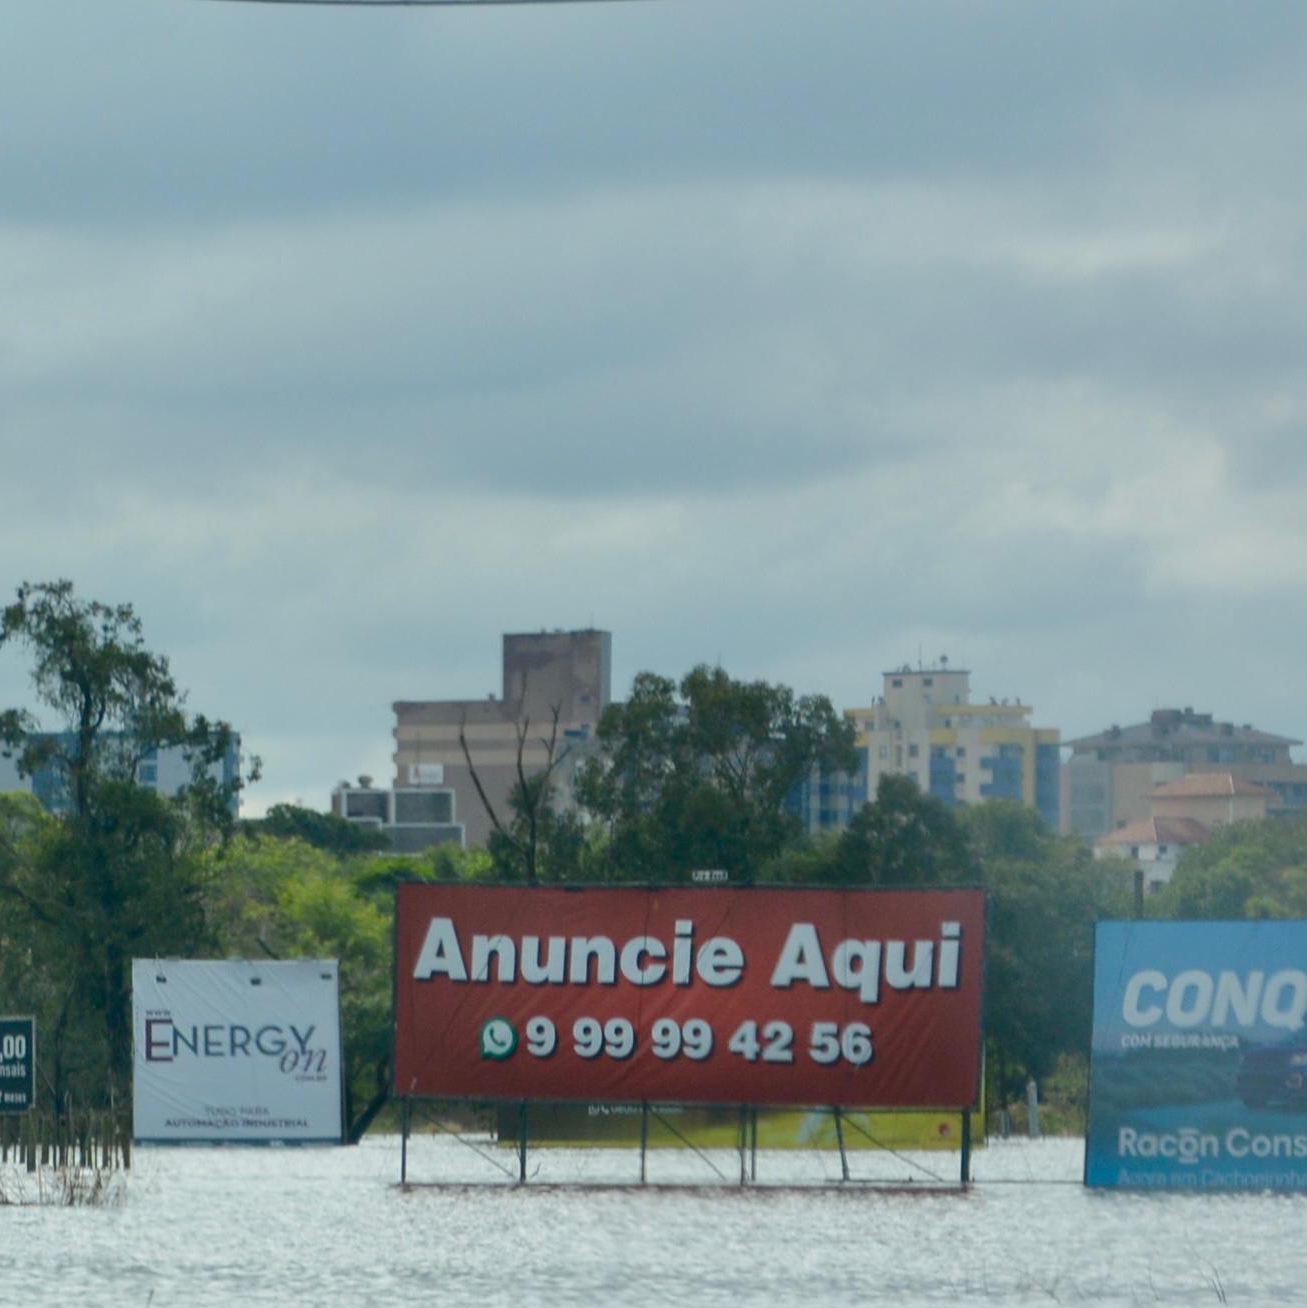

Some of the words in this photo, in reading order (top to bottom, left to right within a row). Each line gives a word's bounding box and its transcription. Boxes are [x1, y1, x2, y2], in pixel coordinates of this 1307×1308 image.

[412, 915, 745, 988] Anuncie
[770, 920, 962, 1004] Aqui
[1122, 969, 1307, 1031] CONQ
[145, 1018, 317, 1063] ENERGY
[572, 1016, 635, 1059] 99
[651, 1017, 713, 1061] 99
[728, 1019, 793, 1063] 42
[809, 1021, 873, 1065] 56
[164, 1114, 239, 1129] AUTOMAÇÃO
[242, 1114, 308, 1129] INDUSTRIAL
